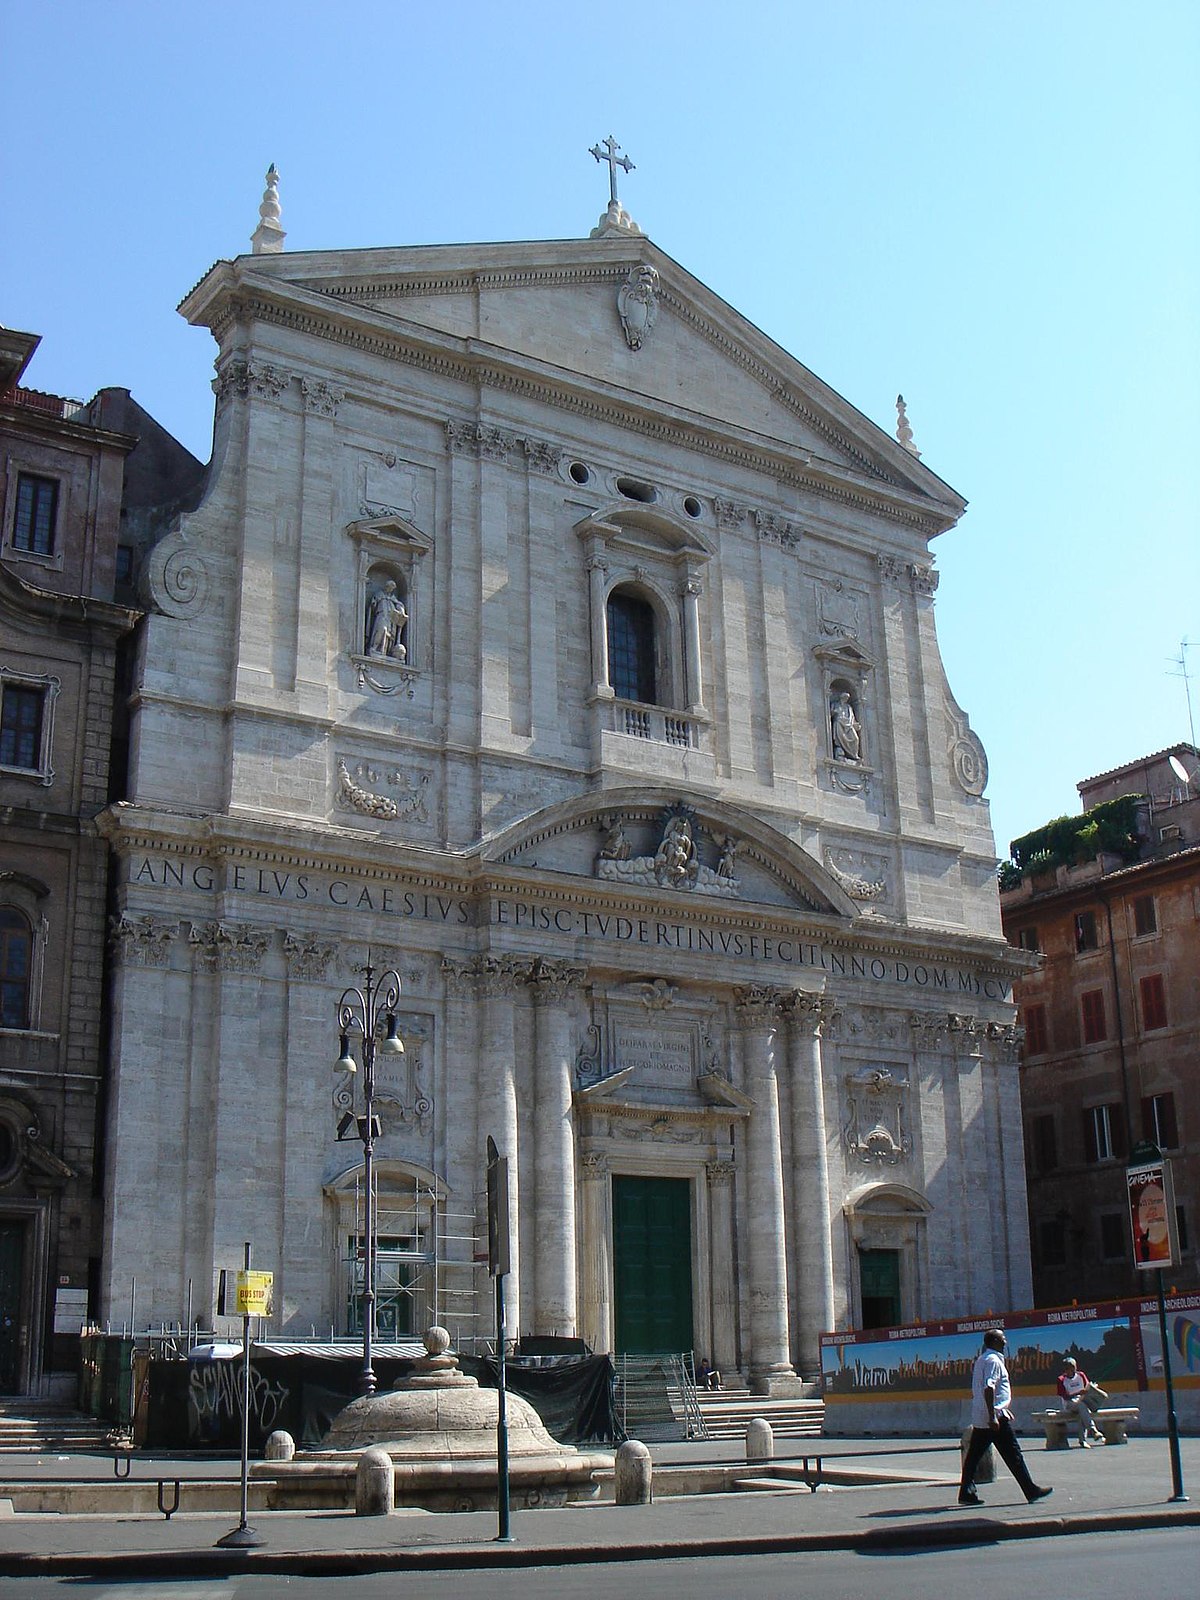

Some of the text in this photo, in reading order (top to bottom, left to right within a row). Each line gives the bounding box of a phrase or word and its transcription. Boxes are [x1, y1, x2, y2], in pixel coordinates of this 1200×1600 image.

[136, 857, 309, 899] ANGELVS
[328, 880, 470, 924] CAESIVS
[496, 900, 572, 932] EPISC
[578, 911, 745, 955] TVDERTINVS
[749, 935, 818, 965] FECIT
[895, 961, 949, 990] DOM
[1128, 1171, 1157, 1187] CINEMA
[240, 1289, 265, 1298] BUS STOP
